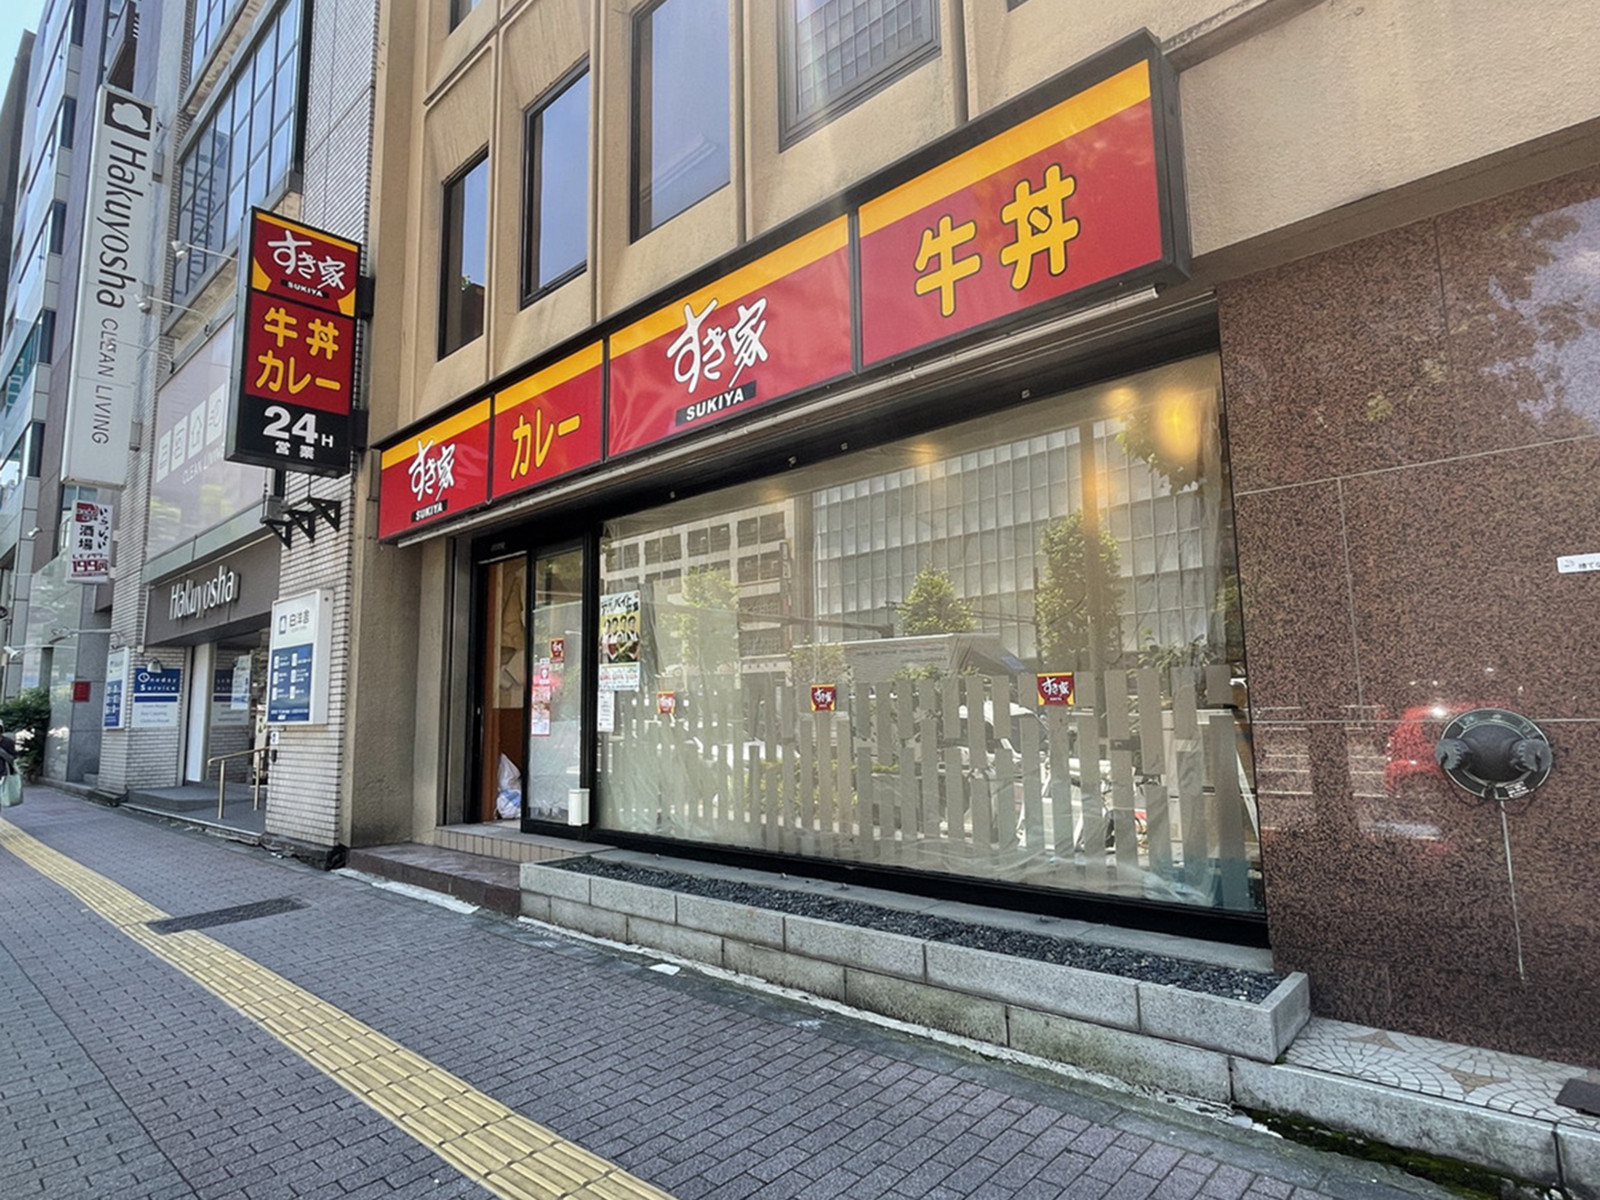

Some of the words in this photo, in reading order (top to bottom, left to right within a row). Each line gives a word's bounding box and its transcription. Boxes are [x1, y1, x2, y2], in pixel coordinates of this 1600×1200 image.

[96, 140, 148, 310] Hakuyosha
[914, 162, 1080, 319] 牛丼
[267, 229, 346, 290] すき家
[286, 280, 324, 298] SUKIYA
[97, 317, 119, 378] CLEAN
[263, 306, 340, 361] 牛丼
[666, 297, 769, 394] すき家
[255, 349, 341, 395] カレー
[91, 384, 113, 445] LIVING
[685, 388, 746, 422] SUKIYA
[274, 440, 315, 460] 営業
[407, 437, 457, 503] すき家
[510, 407, 581, 480] カレー
[78, 525, 95, 551] 酒場
[415, 502, 444, 522] SUKIYA
[168, 565, 236, 621] Hakuyosha
[137, 672, 177, 683] Oneday
[140, 684, 176, 692] Service
